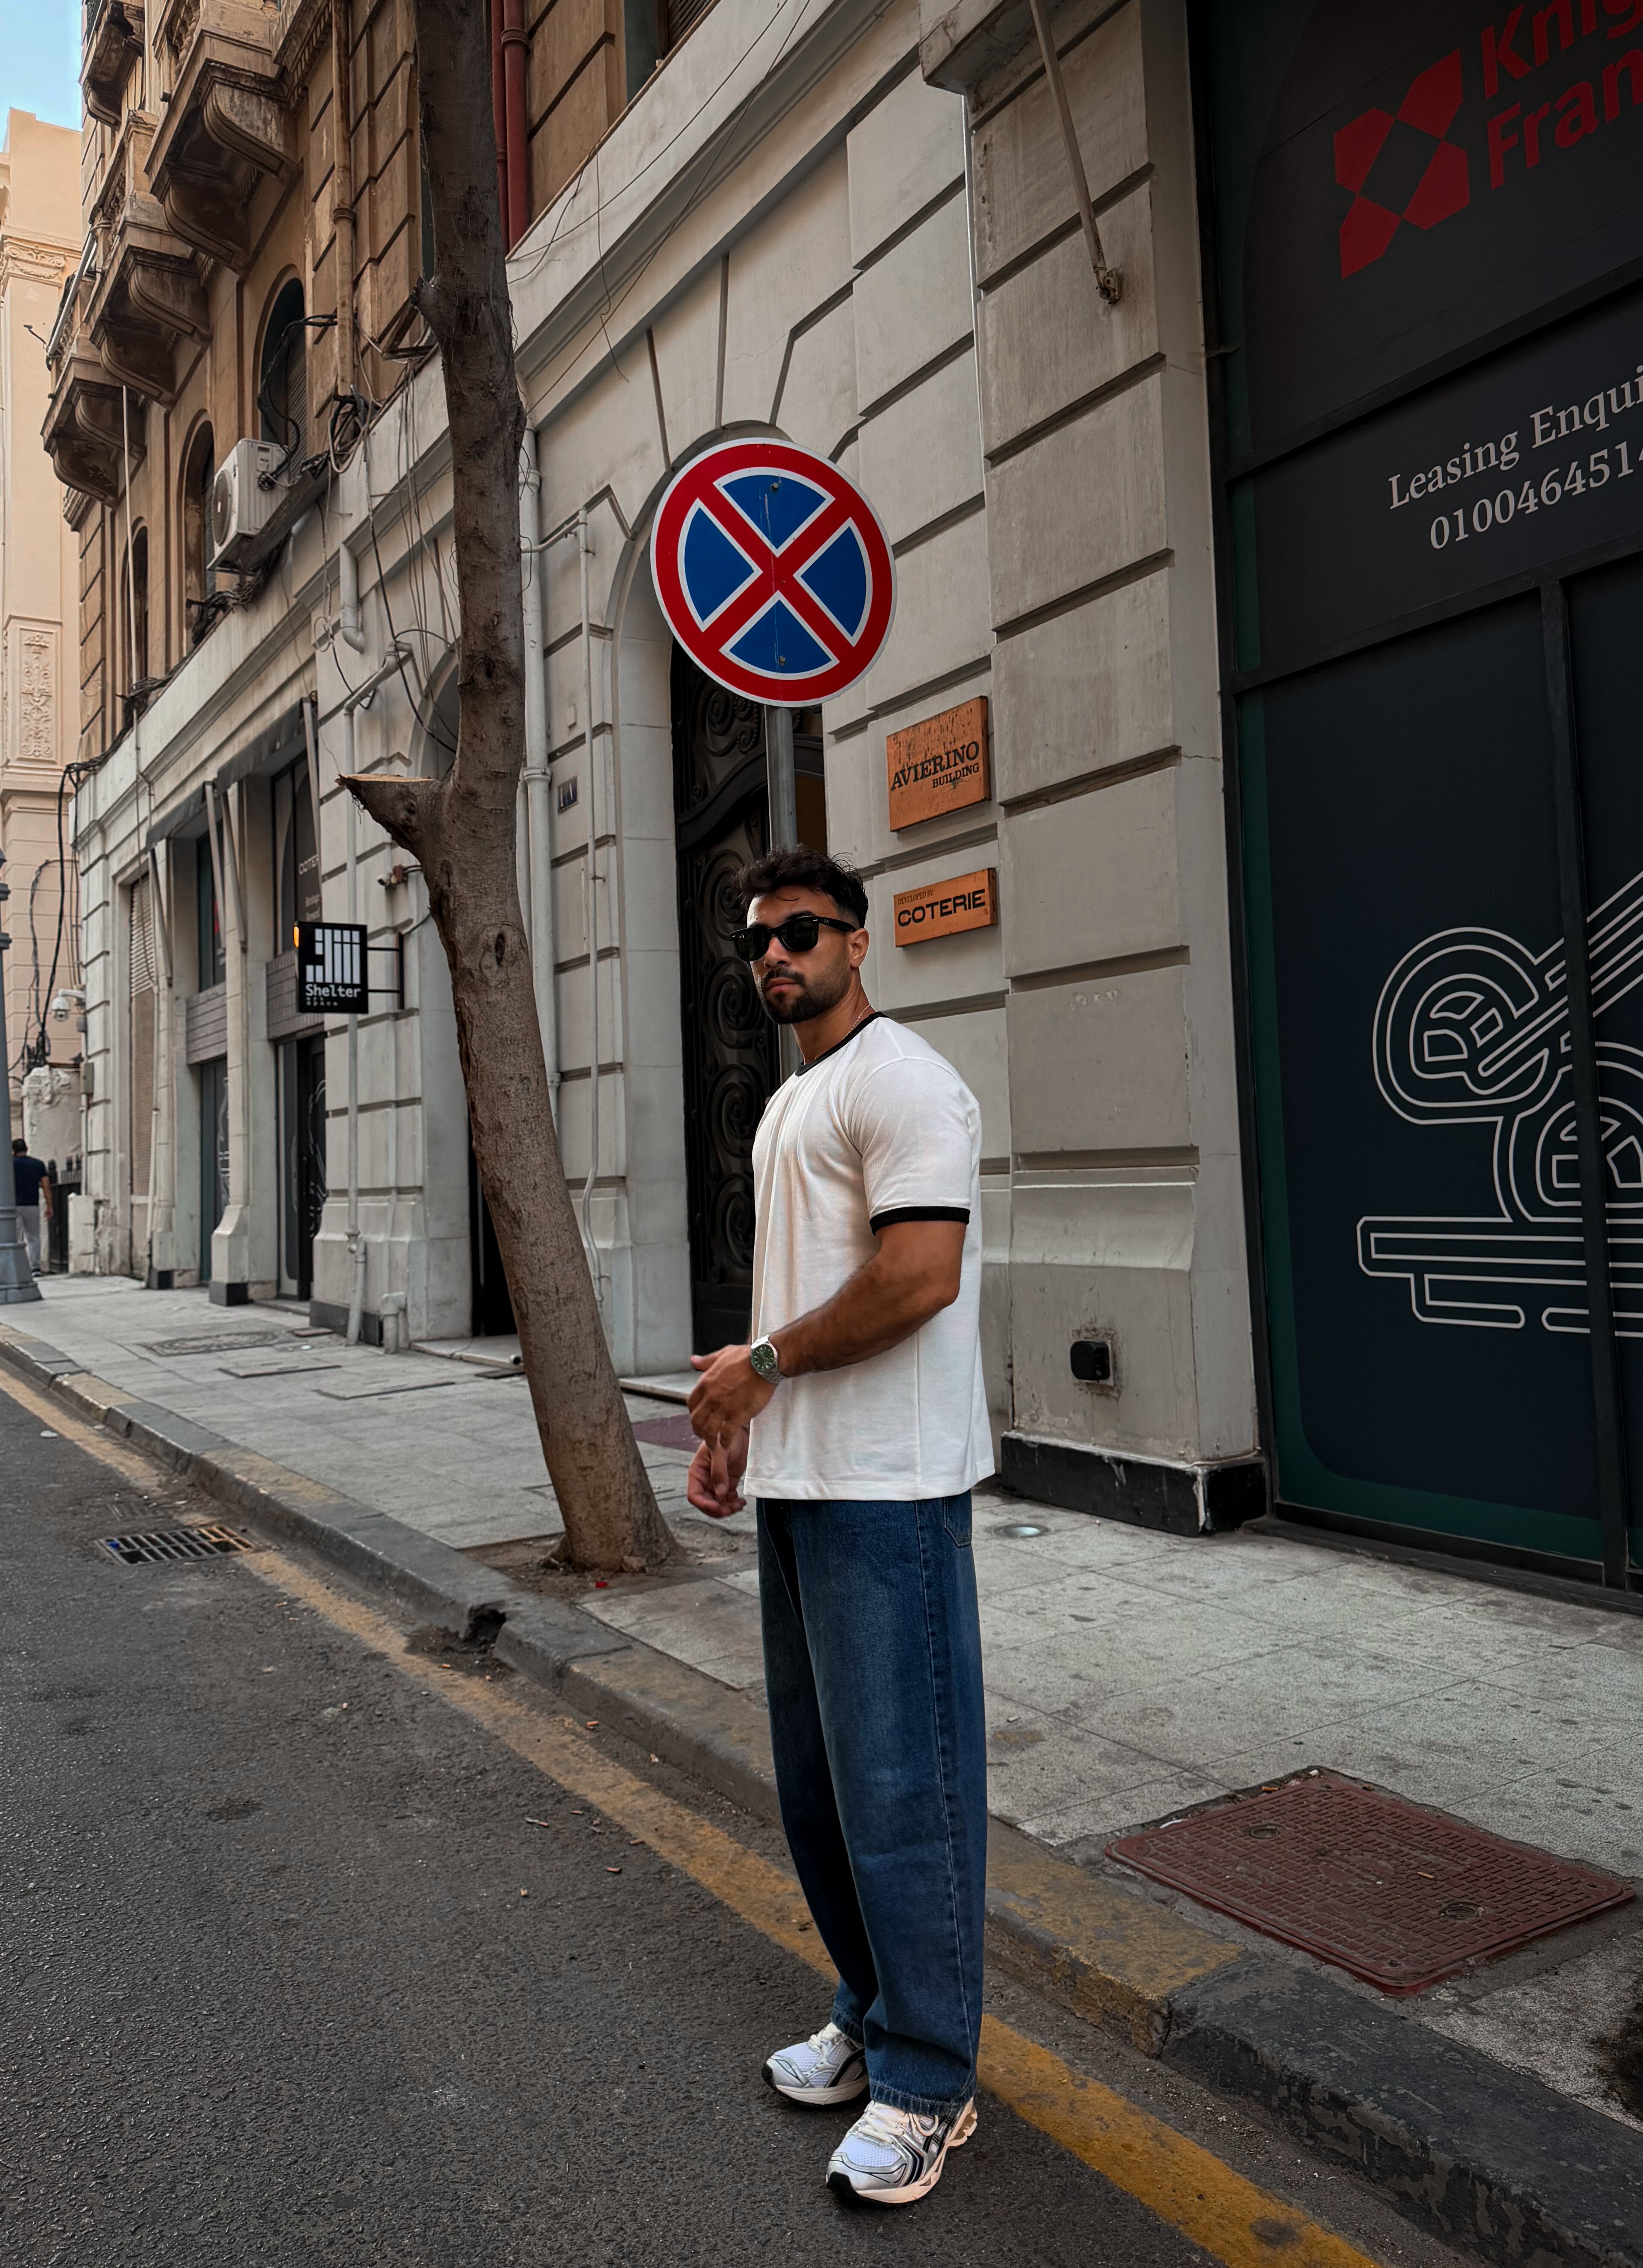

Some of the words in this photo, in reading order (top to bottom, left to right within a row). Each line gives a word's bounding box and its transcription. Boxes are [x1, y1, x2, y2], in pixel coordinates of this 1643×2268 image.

[1487, 49, 1643, 190] Fran
[1388, 431, 1518, 509] Leasing
[1530, 365, 1643, 449] Enqui
[1430, 441, 1643, 550] 010046451
[890, 741, 979, 792] AVIERINO
[932, 763, 979, 788] BUILDING
[898, 891, 927, 905] DEVELOPED
[927, 889, 934, 898] BY
[898, 888, 985, 927] COTERIE
[305, 983, 362, 998] Shelter
